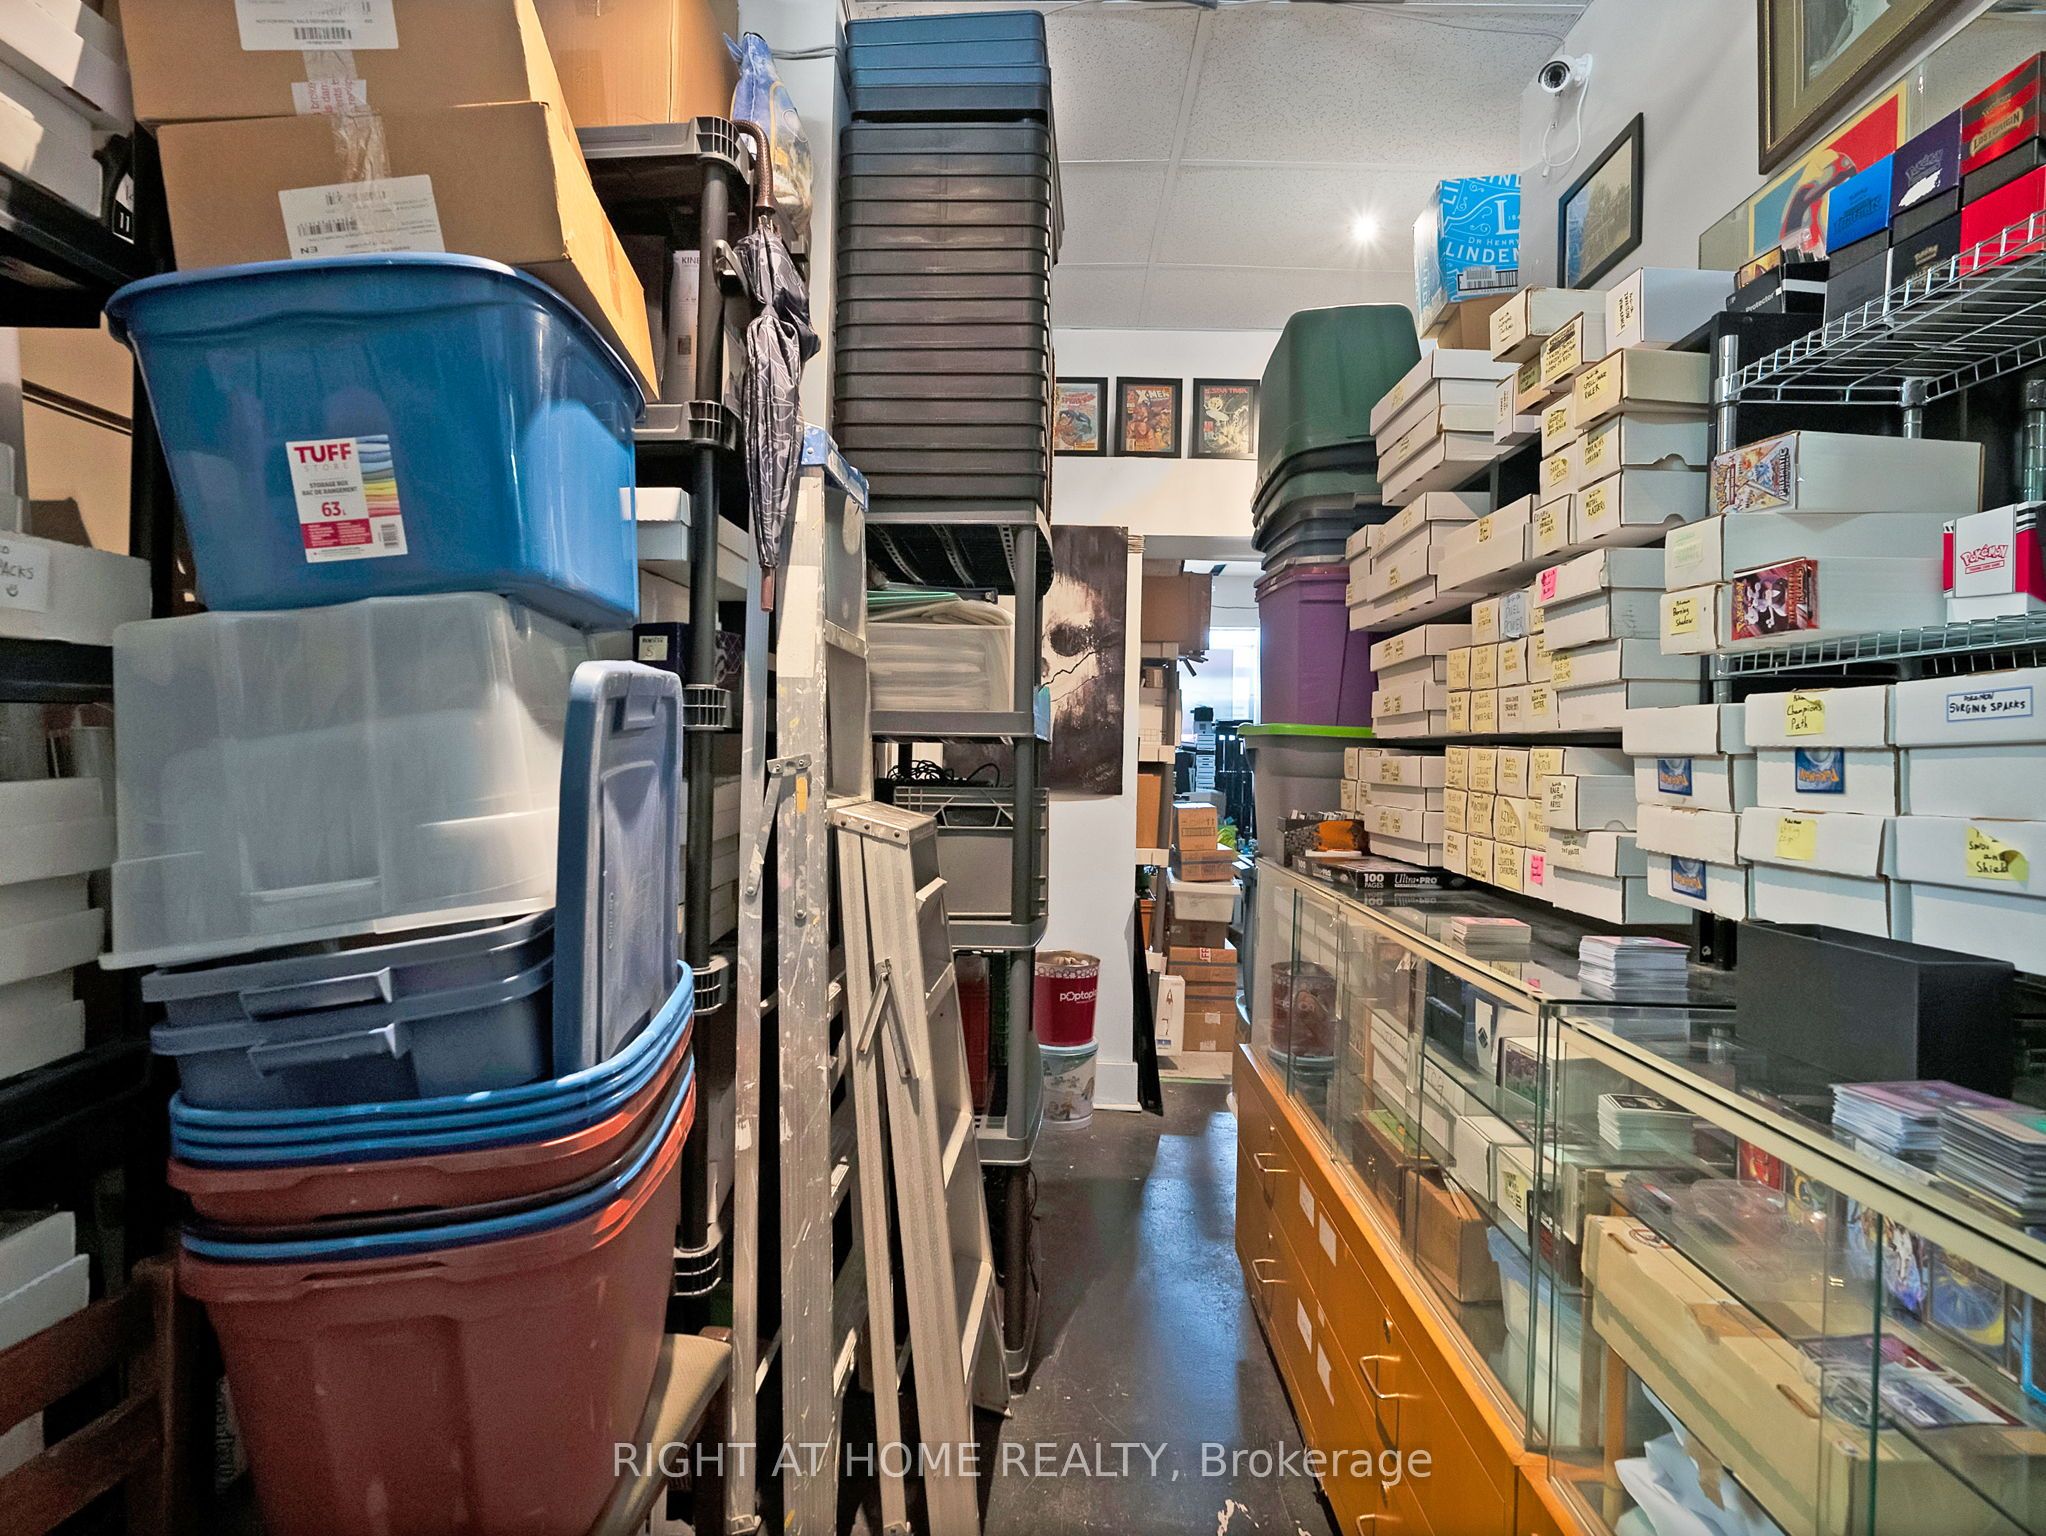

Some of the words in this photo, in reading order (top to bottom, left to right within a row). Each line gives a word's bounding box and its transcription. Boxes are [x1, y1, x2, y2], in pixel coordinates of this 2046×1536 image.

[294, 442, 352, 463] TUFF
[321, 500, 342, 517] 63
[0, 561, 34, 580] ACKS
[1949, 702, 1987, 714] SURGING
[1990, 700, 2026, 712] SPARKS
[1791, 717, 1808, 731] Path
[1976, 860, 2009, 873] Shield
[1363, 873, 1385, 882] 100
[1364, 881, 1385, 889] PAGES
